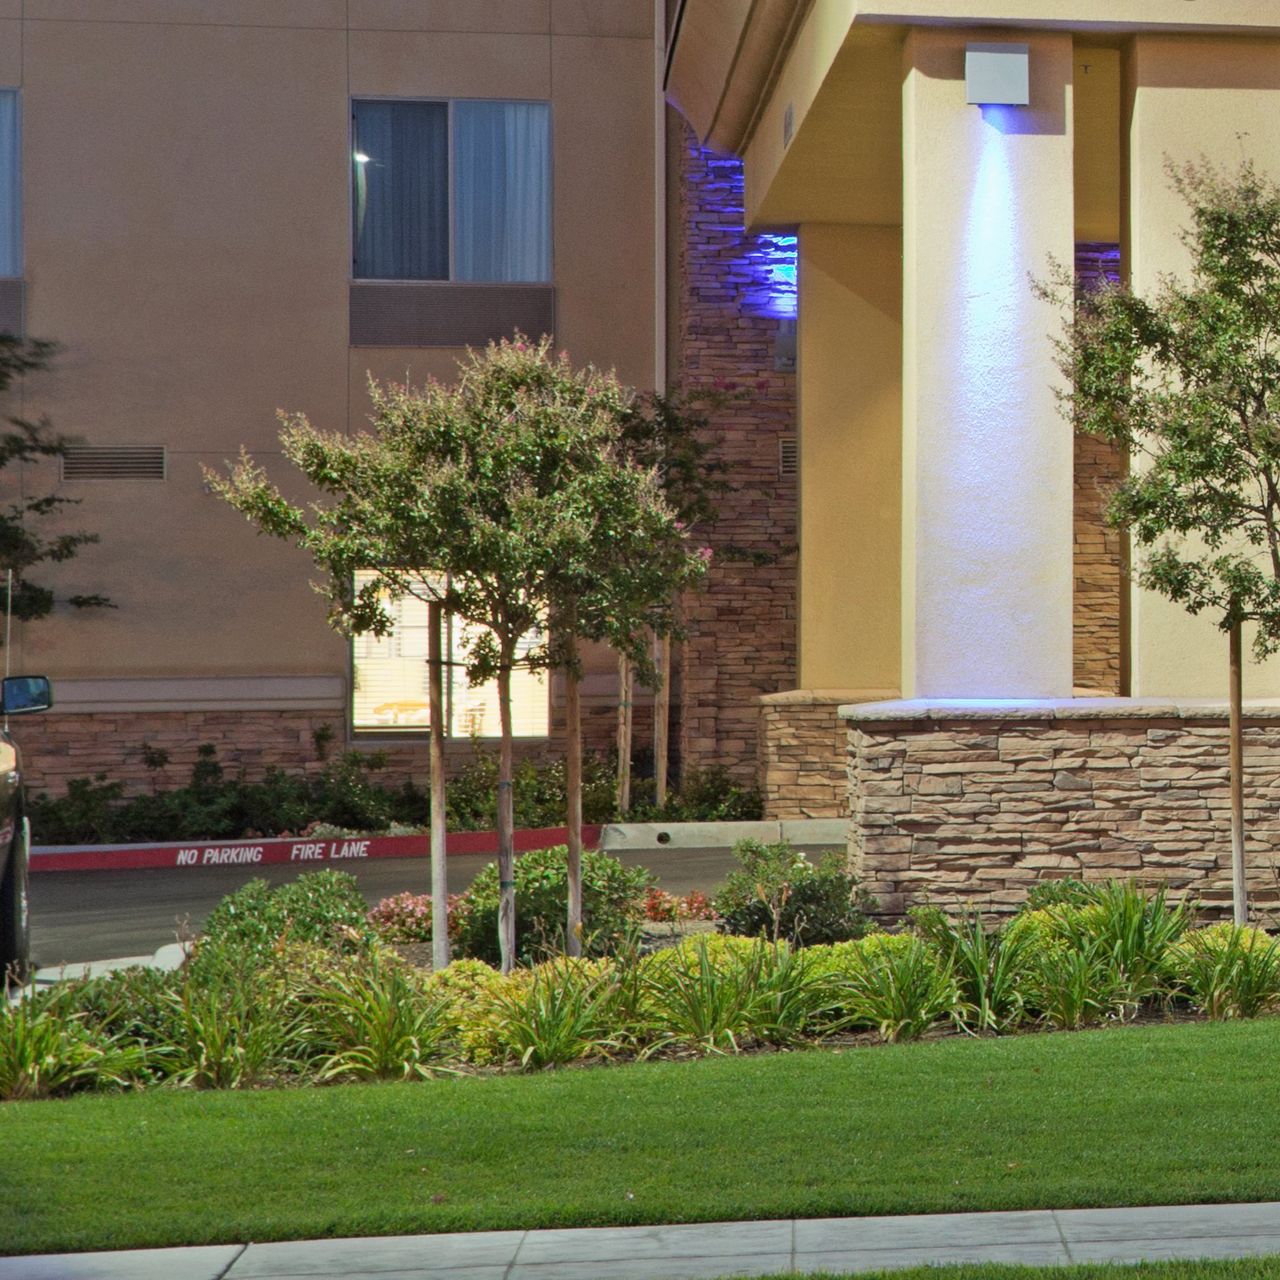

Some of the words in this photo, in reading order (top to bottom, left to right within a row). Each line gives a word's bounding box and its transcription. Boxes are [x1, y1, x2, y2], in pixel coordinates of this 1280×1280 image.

[176, 849, 198, 865] NO
[202, 846, 264, 864] PARKING
[291, 843, 326, 860] FIRE
[330, 841, 371, 858] LANE
